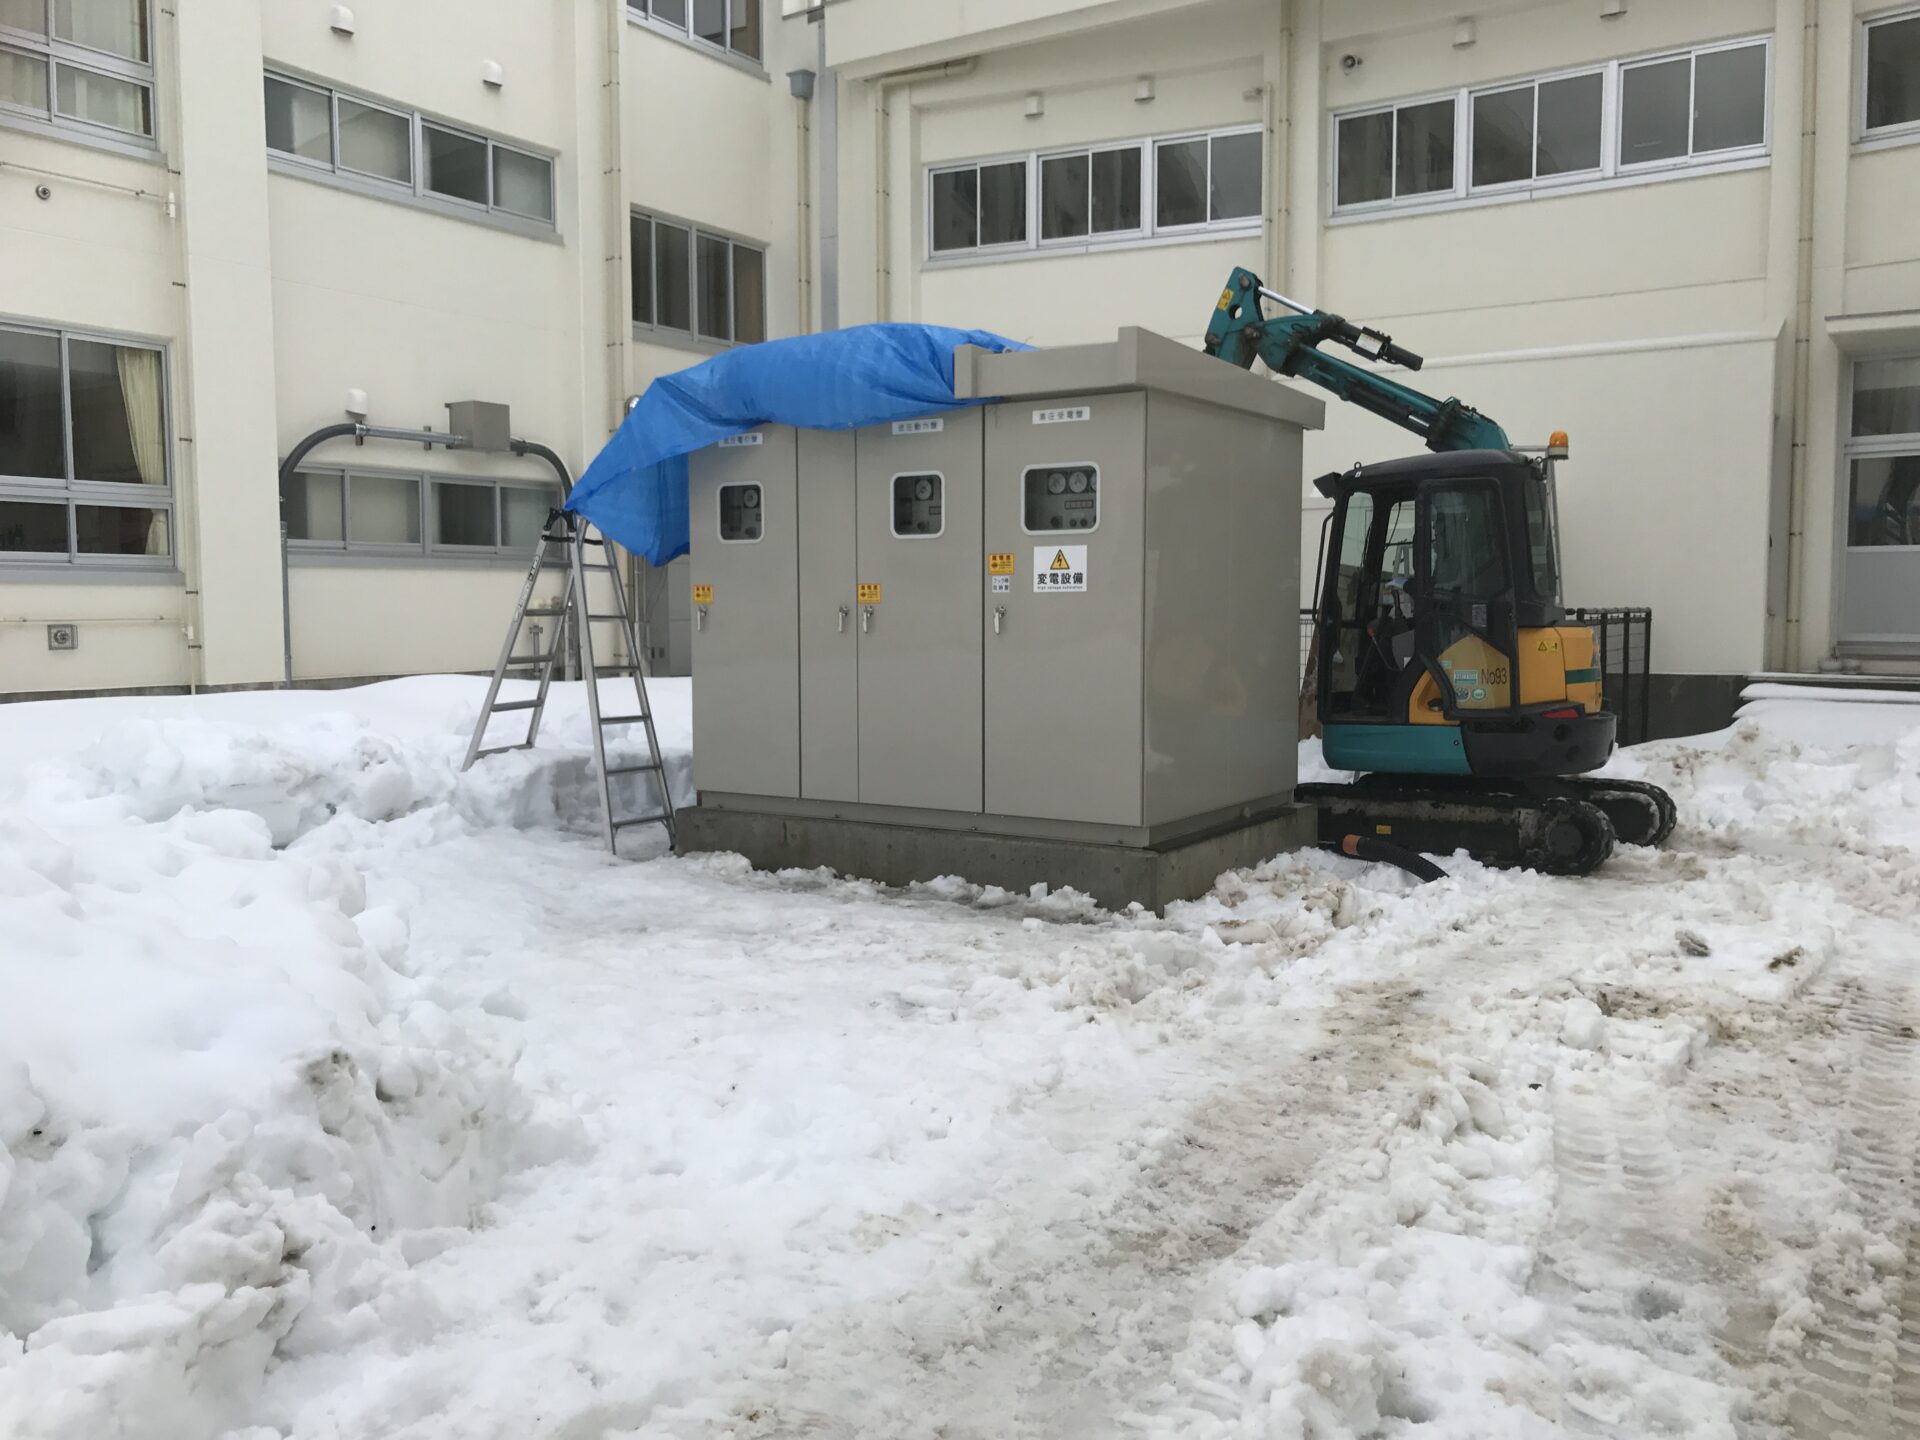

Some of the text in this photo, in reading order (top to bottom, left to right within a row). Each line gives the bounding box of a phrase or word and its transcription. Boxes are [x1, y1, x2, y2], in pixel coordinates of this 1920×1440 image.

[1037, 572, 1083, 585] 変電設備
[1481, 667, 1507, 685] No93
